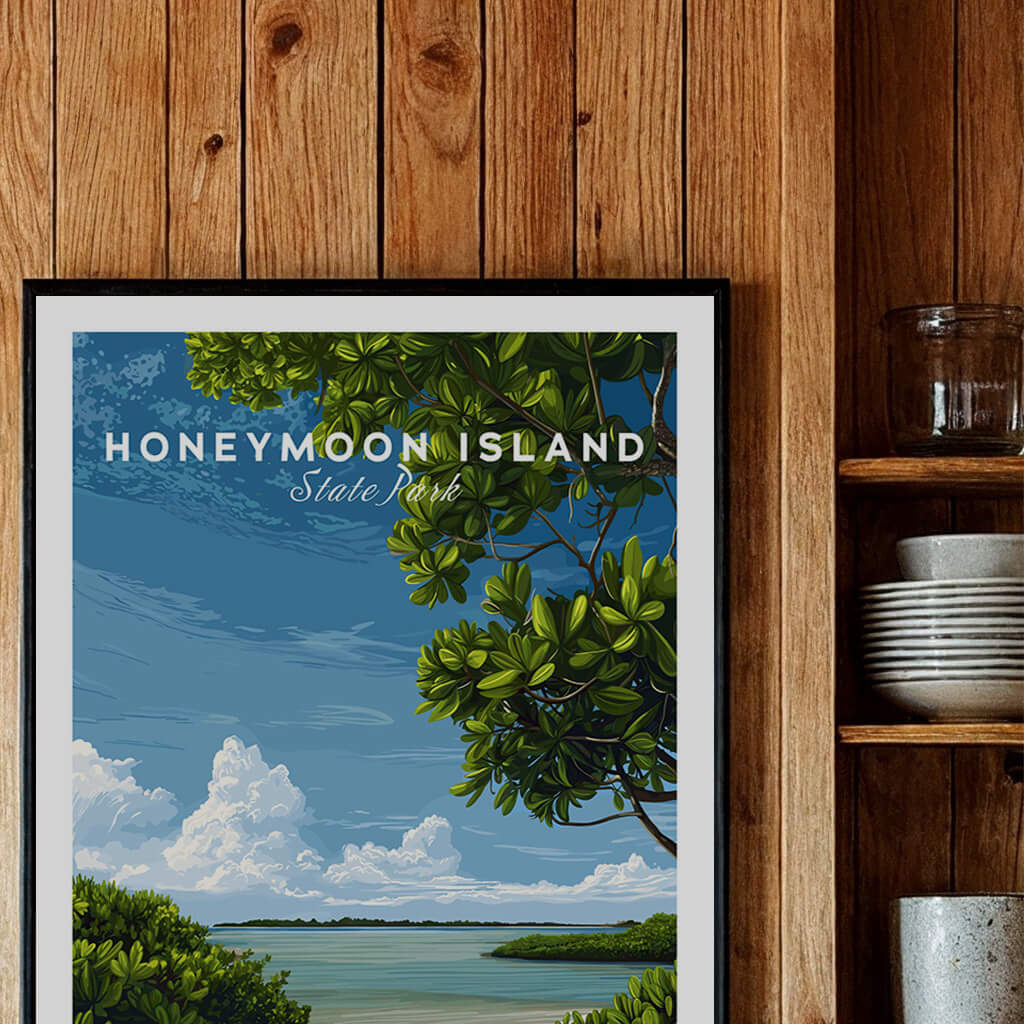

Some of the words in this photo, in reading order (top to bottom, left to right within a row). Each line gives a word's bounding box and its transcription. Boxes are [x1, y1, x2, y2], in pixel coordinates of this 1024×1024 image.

[105, 431, 427, 462] HONEYMOON
[460, 431, 645, 462] ISLAND
[290, 467, 379, 502] State
[375, 463, 463, 506] Park
